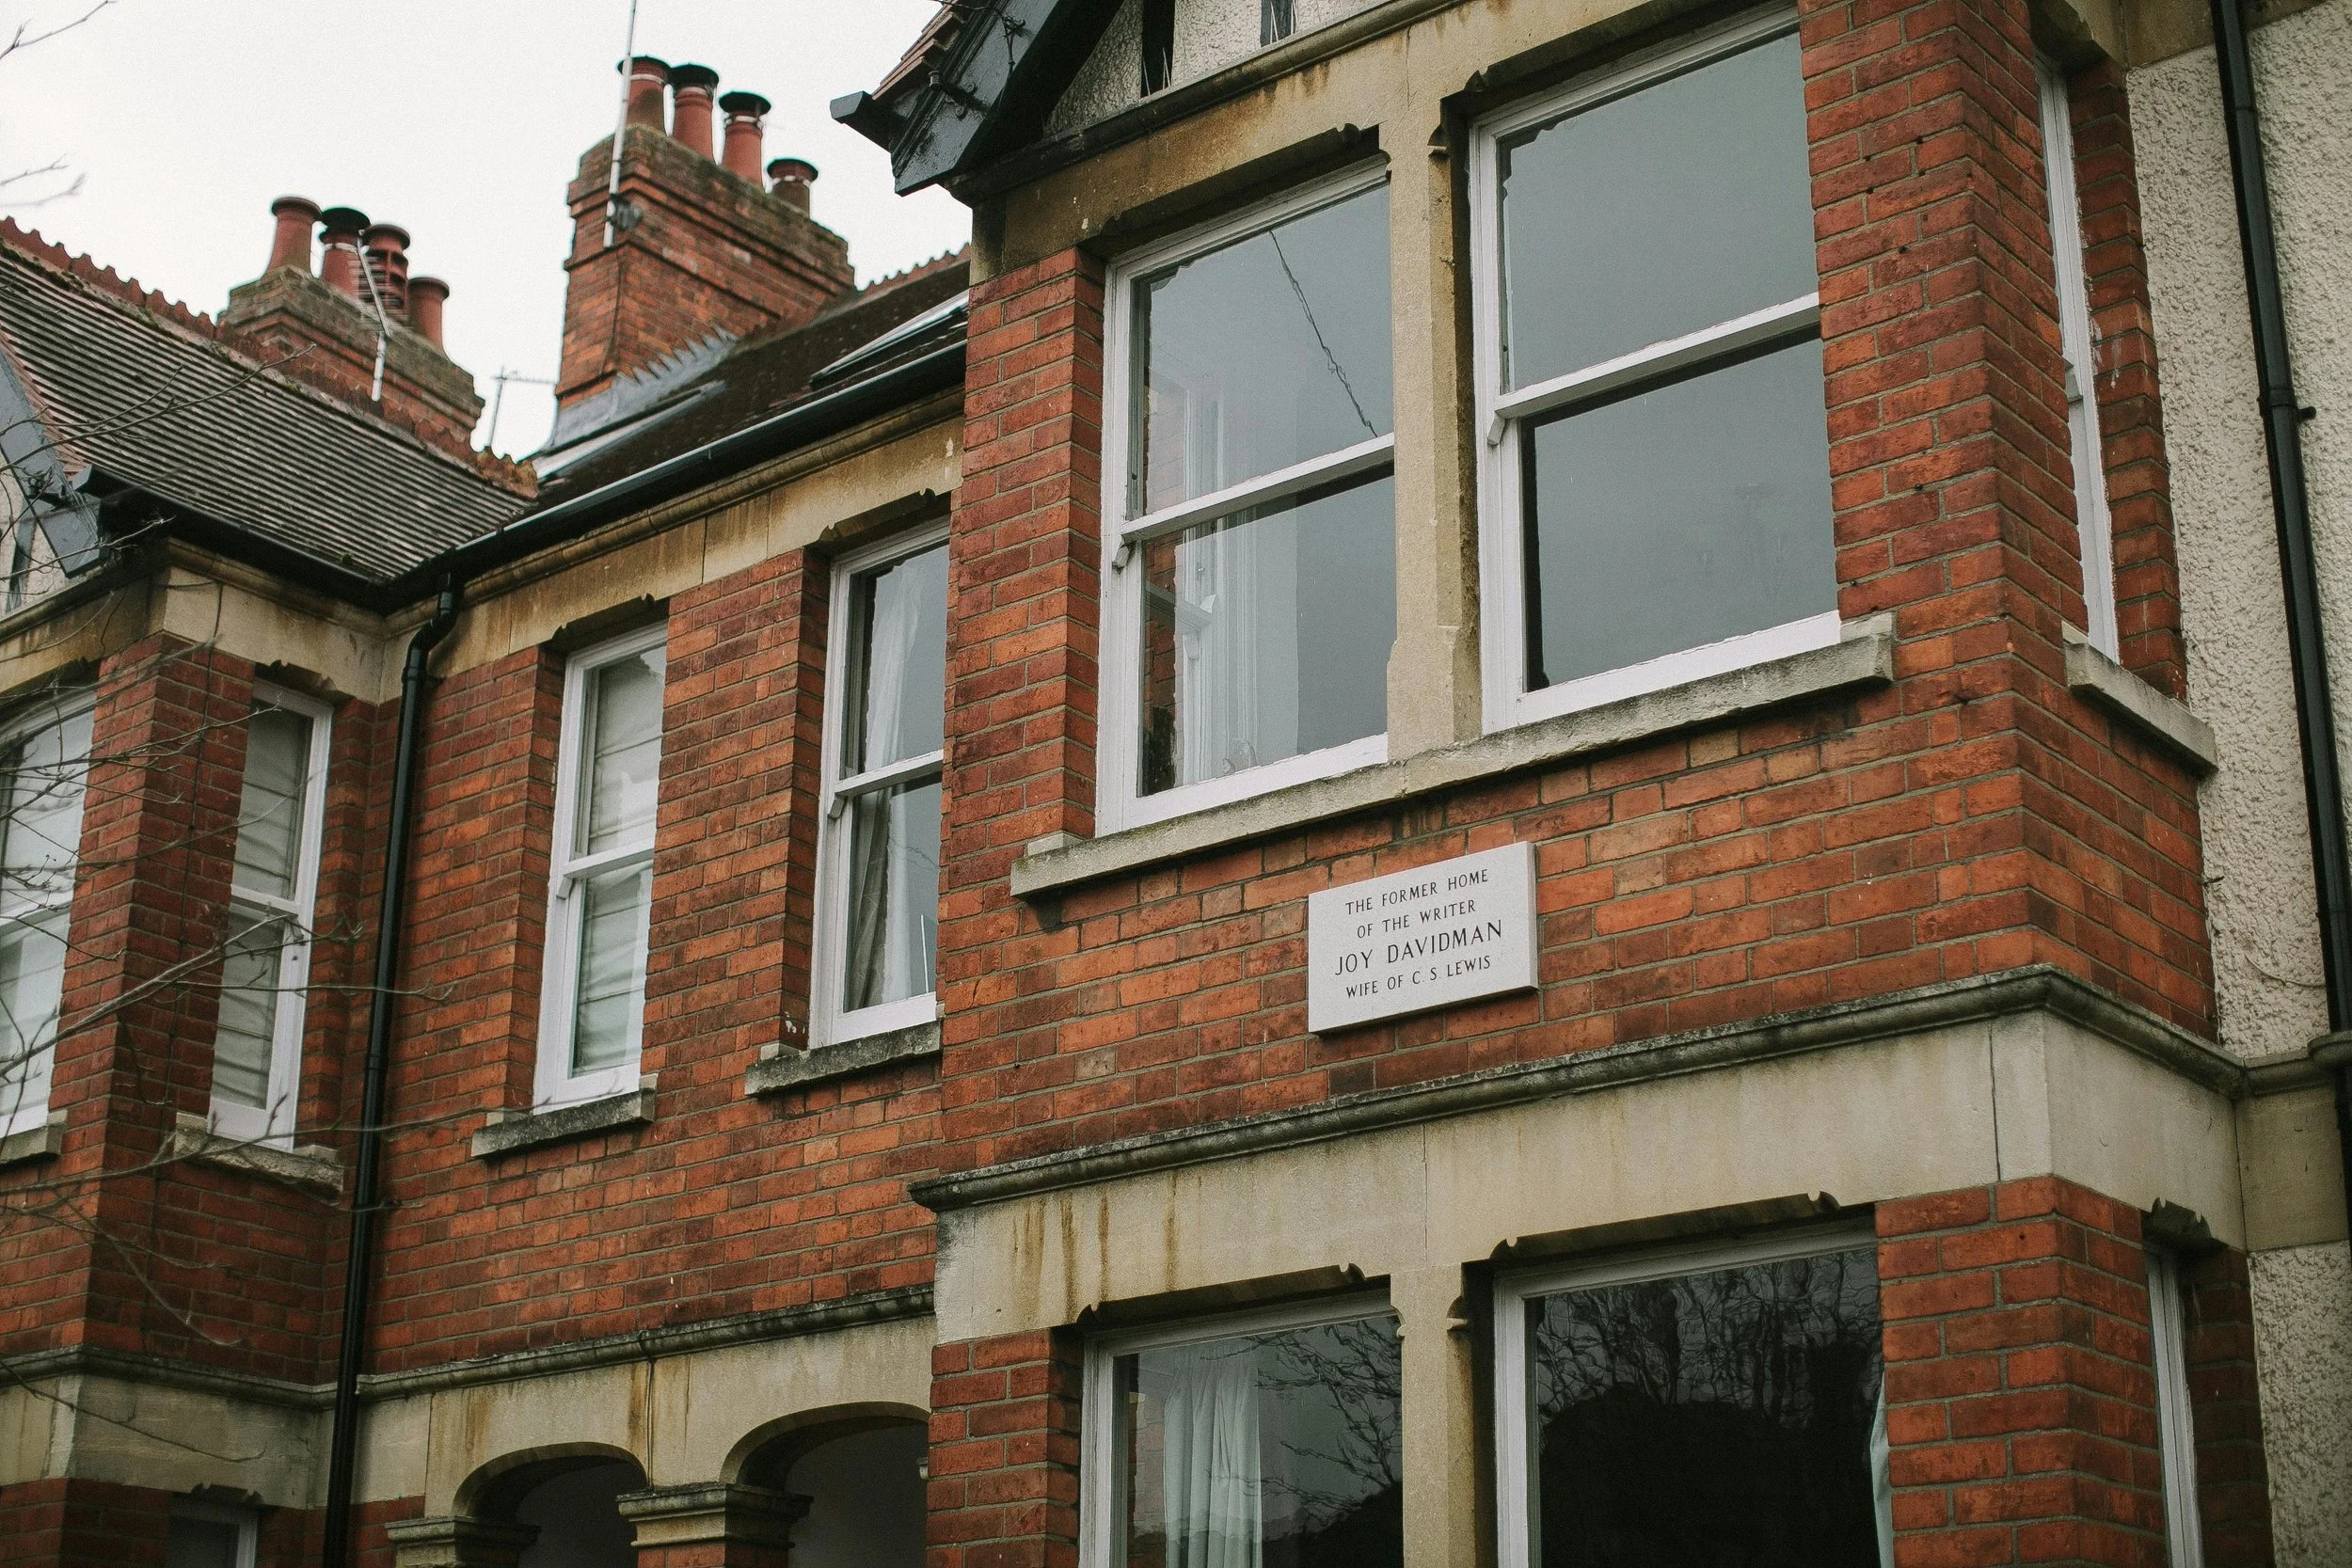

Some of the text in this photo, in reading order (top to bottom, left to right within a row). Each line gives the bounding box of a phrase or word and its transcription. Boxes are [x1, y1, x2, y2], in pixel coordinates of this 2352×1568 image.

[1345, 868, 1488, 915] THE FORMER HOME
[1357, 899, 1476, 939] OF THE WRITER
[1335, 919, 1502, 975] JOY DAVIDMAN
[1345, 980, 1378, 999] WIFE
[1387, 974, 1404, 990] OF
[1447, 955, 1491, 977] LEWIS
